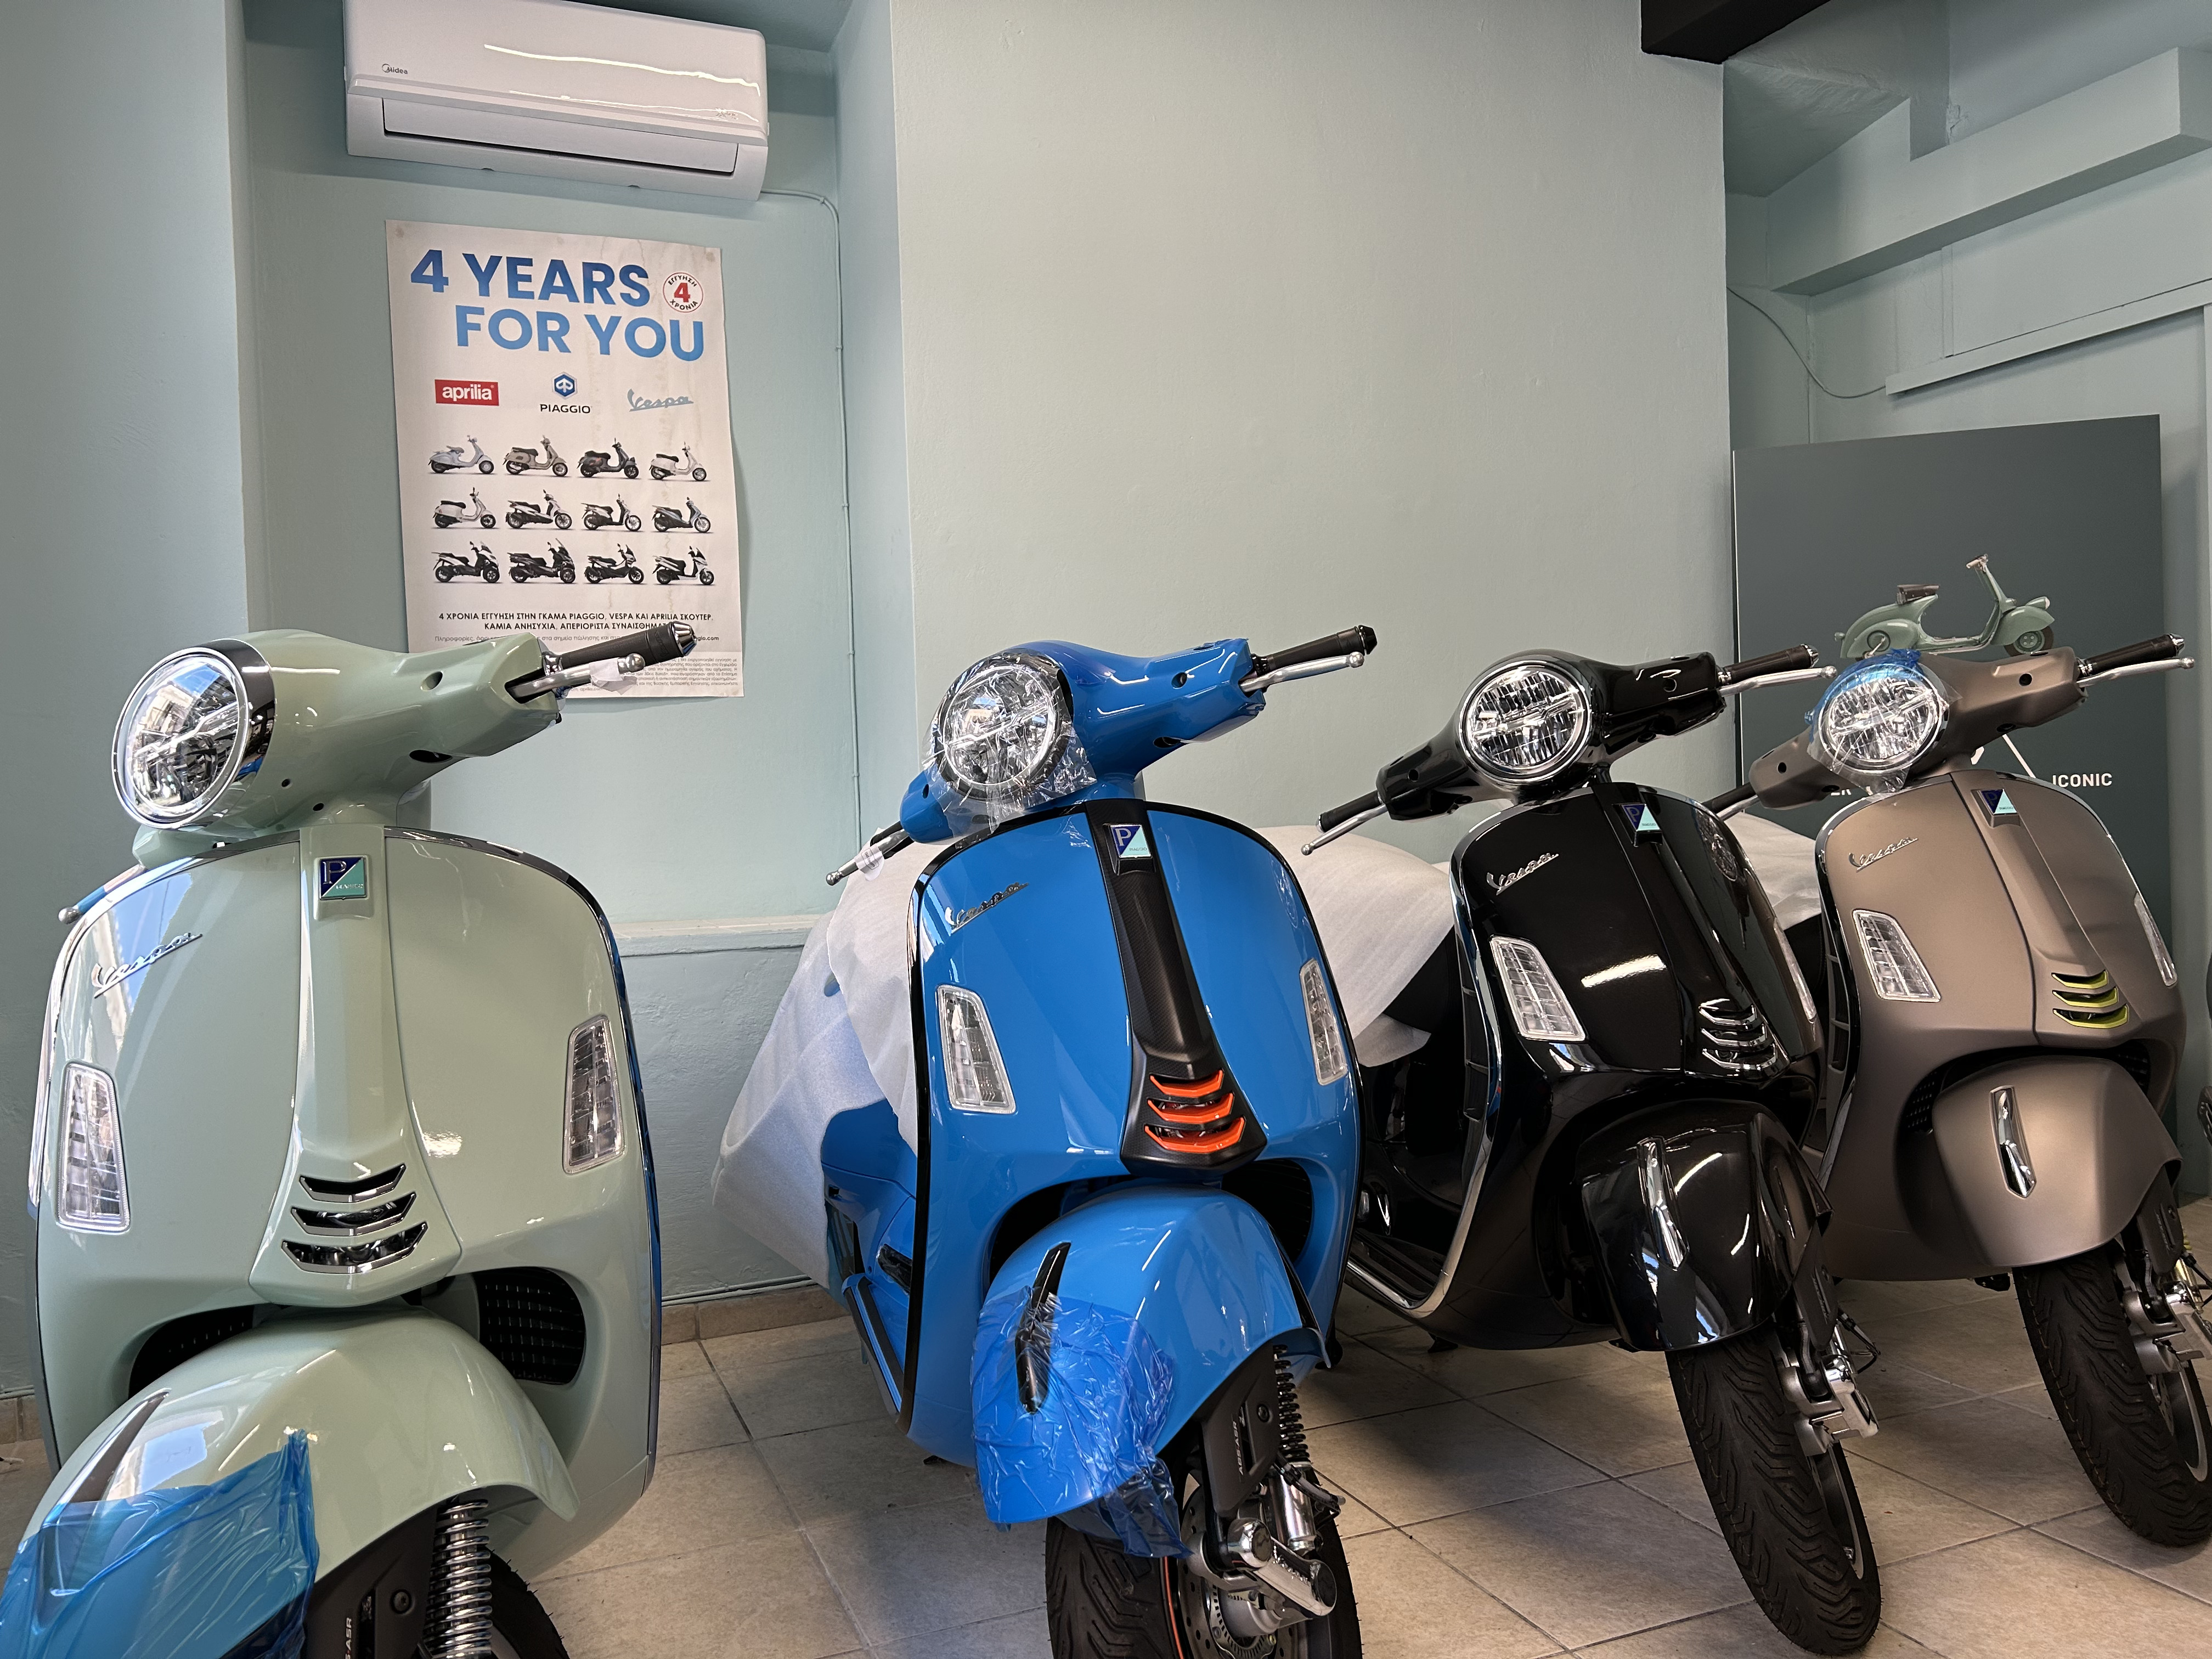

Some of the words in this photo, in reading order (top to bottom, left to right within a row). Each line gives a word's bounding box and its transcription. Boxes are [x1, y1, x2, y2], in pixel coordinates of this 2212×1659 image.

[382, 64, 408, 74] Midea
[410, 250, 449, 292] 4
[462, 253, 650, 307] YEARS
[668, 275, 697, 286] ΕΓΓΥΗΣΗ
[674, 283, 691, 302] 4
[670, 299, 698, 310] ΧΡΟΝΙΑ
[455, 304, 572, 353] FOR
[584, 314, 704, 362] YOU
[442, 384, 492, 402] aprilia
[628, 388, 694, 412] Vespa
[540, 404, 591, 414] PIAGGIO
[2052, 773, 2112, 787] ICONIC
[1627, 806, 1640, 822] P
[1115, 828, 1131, 846] P
[323, 860, 347, 884] P
[1486, 852, 1559, 895] Vespa
